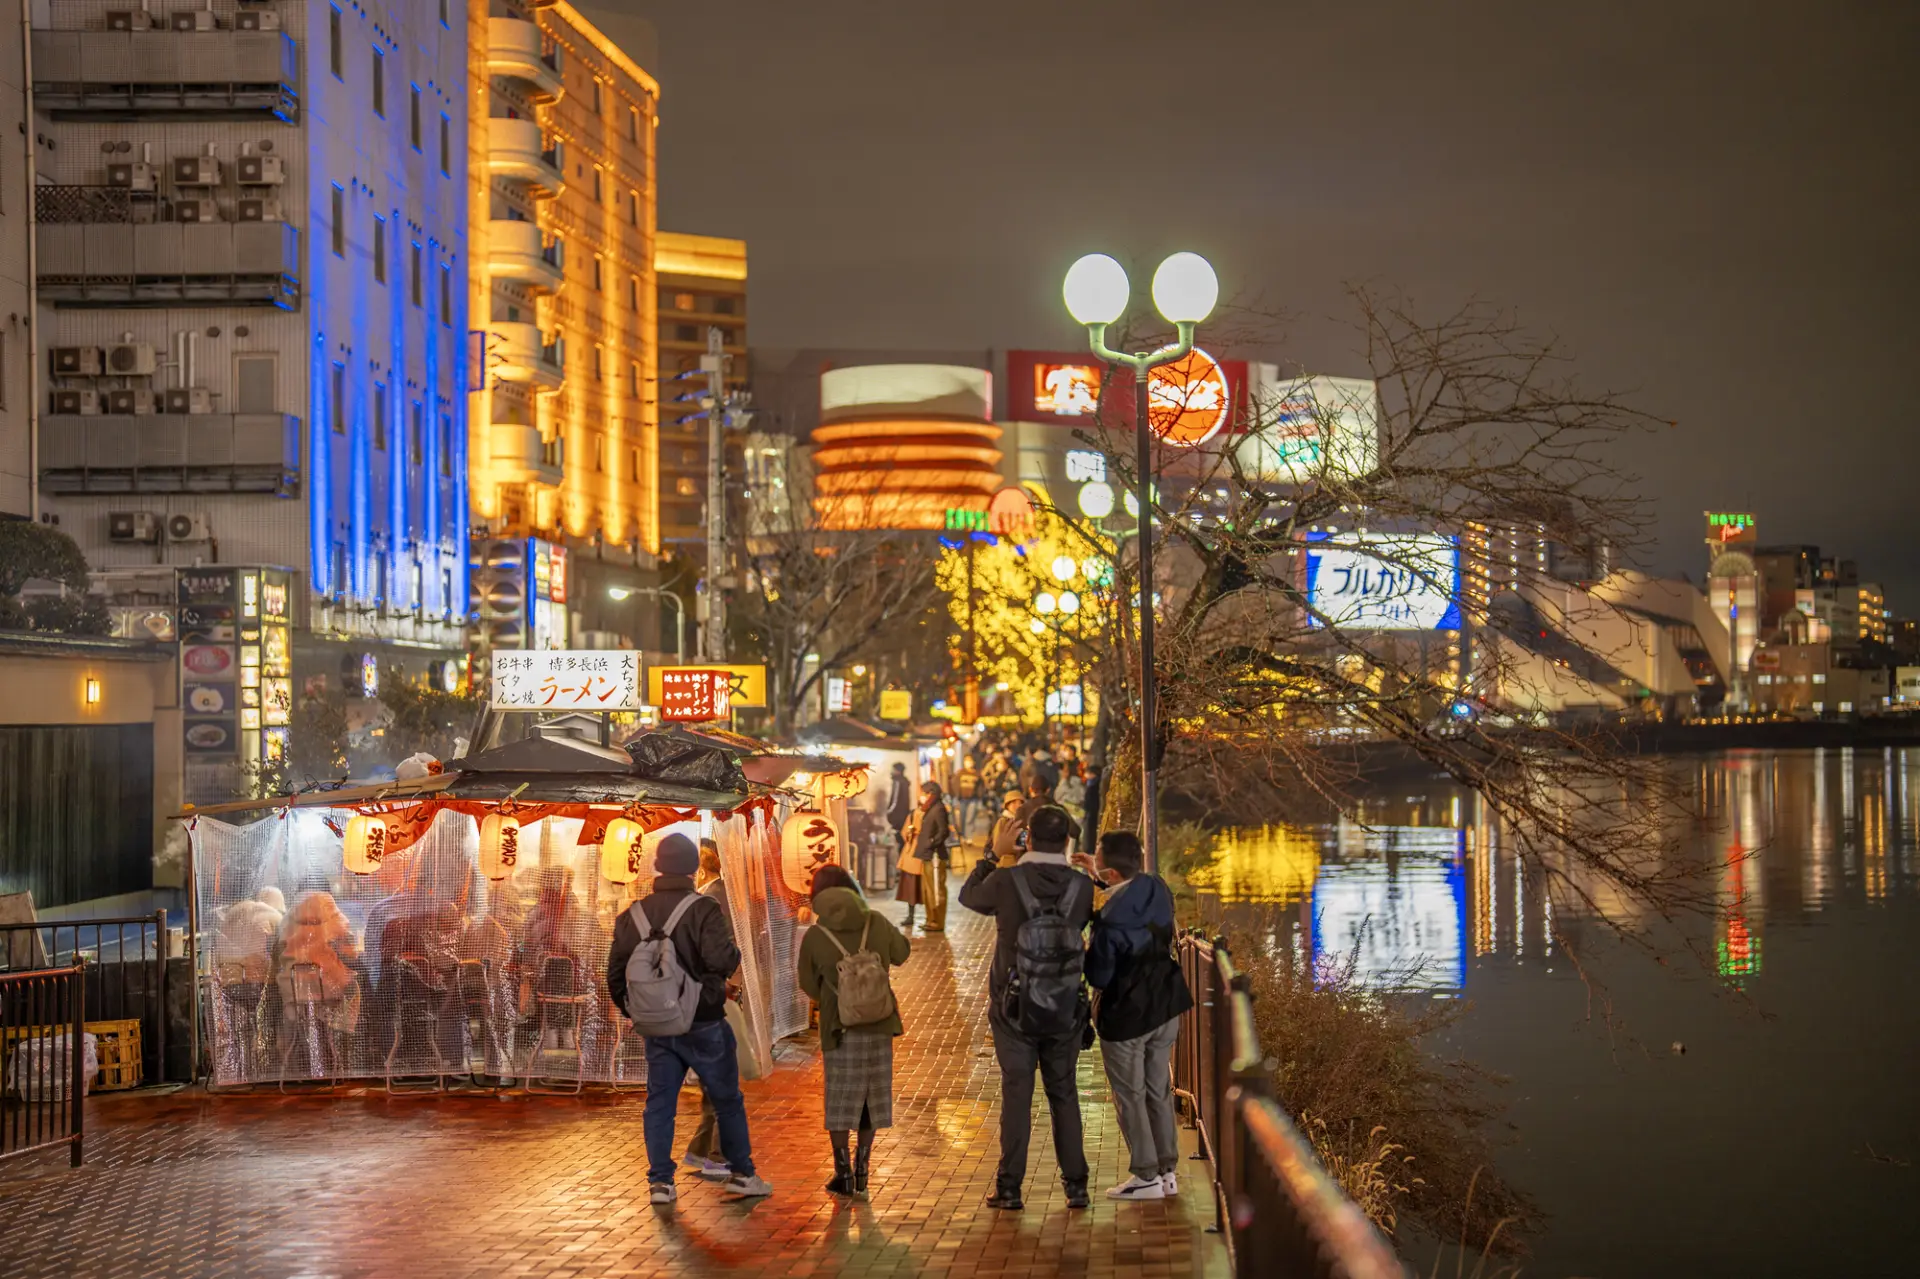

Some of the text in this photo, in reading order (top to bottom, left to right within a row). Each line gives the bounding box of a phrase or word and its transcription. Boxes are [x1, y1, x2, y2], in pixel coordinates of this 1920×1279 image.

[1709, 513, 1754, 526] HOTEL
[496, 657, 508, 705] おでん
[509, 657, 521, 704] 牛タン
[522, 656, 536, 705] 串焼
[549, 656, 608, 672] 博多長浜
[620, 654, 635, 707] 大ちゃん
[540, 676, 618, 705] ラーメン
[701, 673, 710, 716] ラーメン
